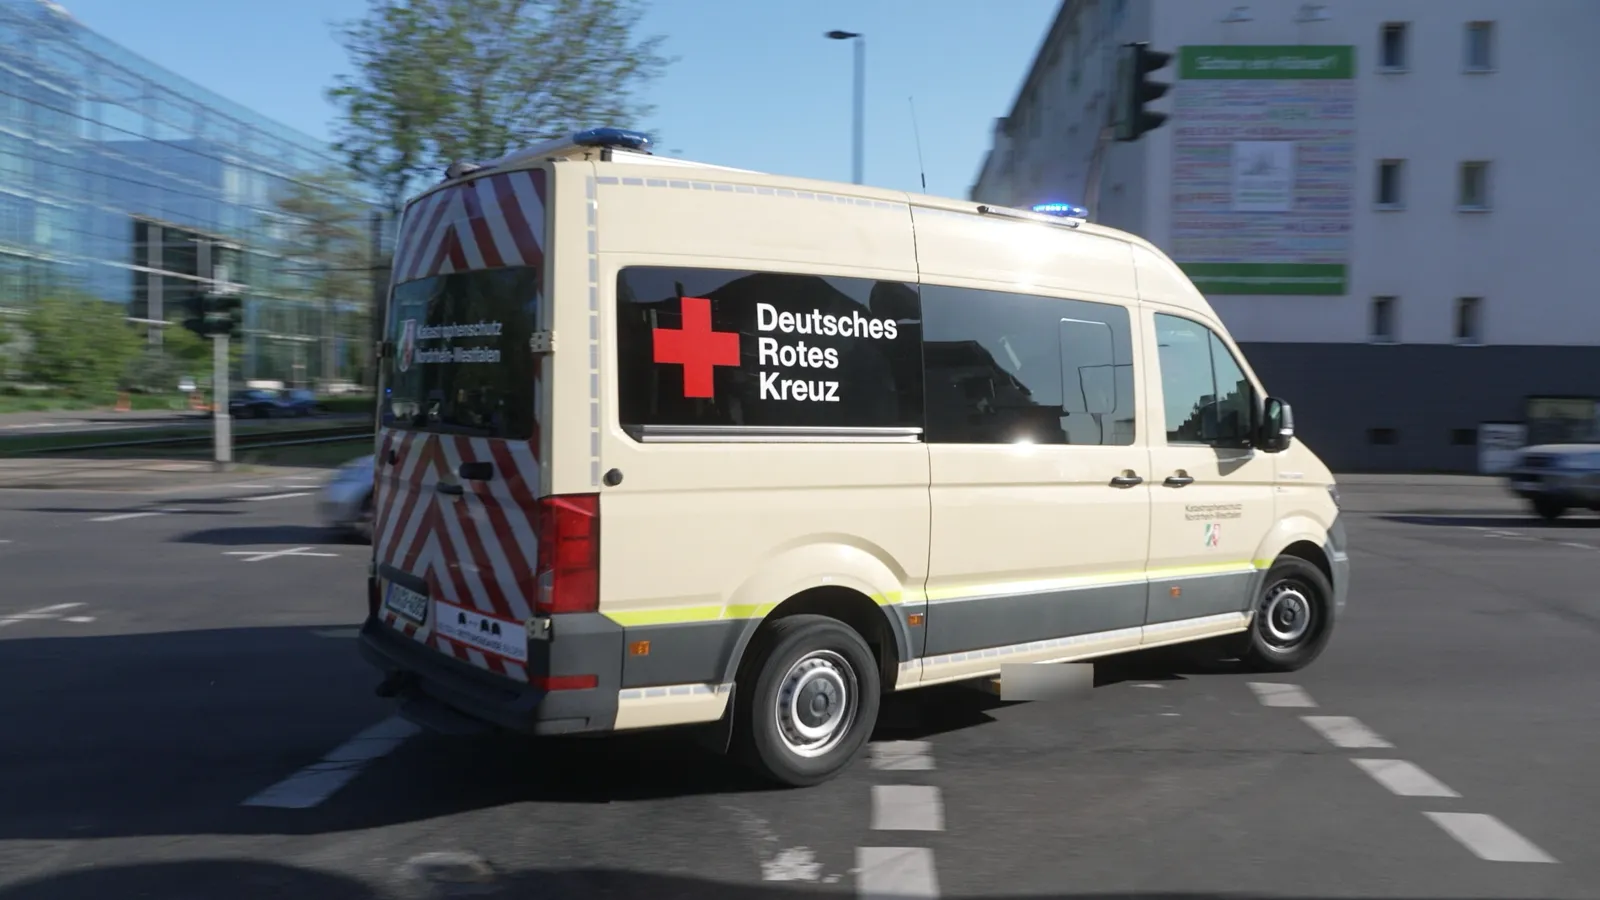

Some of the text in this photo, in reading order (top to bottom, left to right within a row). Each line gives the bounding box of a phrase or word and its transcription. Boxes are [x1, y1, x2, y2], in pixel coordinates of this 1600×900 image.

[417, 321, 503, 341] Katastrophenschutz
[756, 302, 898, 339] Deutsches
[415, 346, 501, 363] Nordrhein-Westfalen
[758, 337, 839, 369] Rotes
[759, 371, 840, 402] Kreuz
